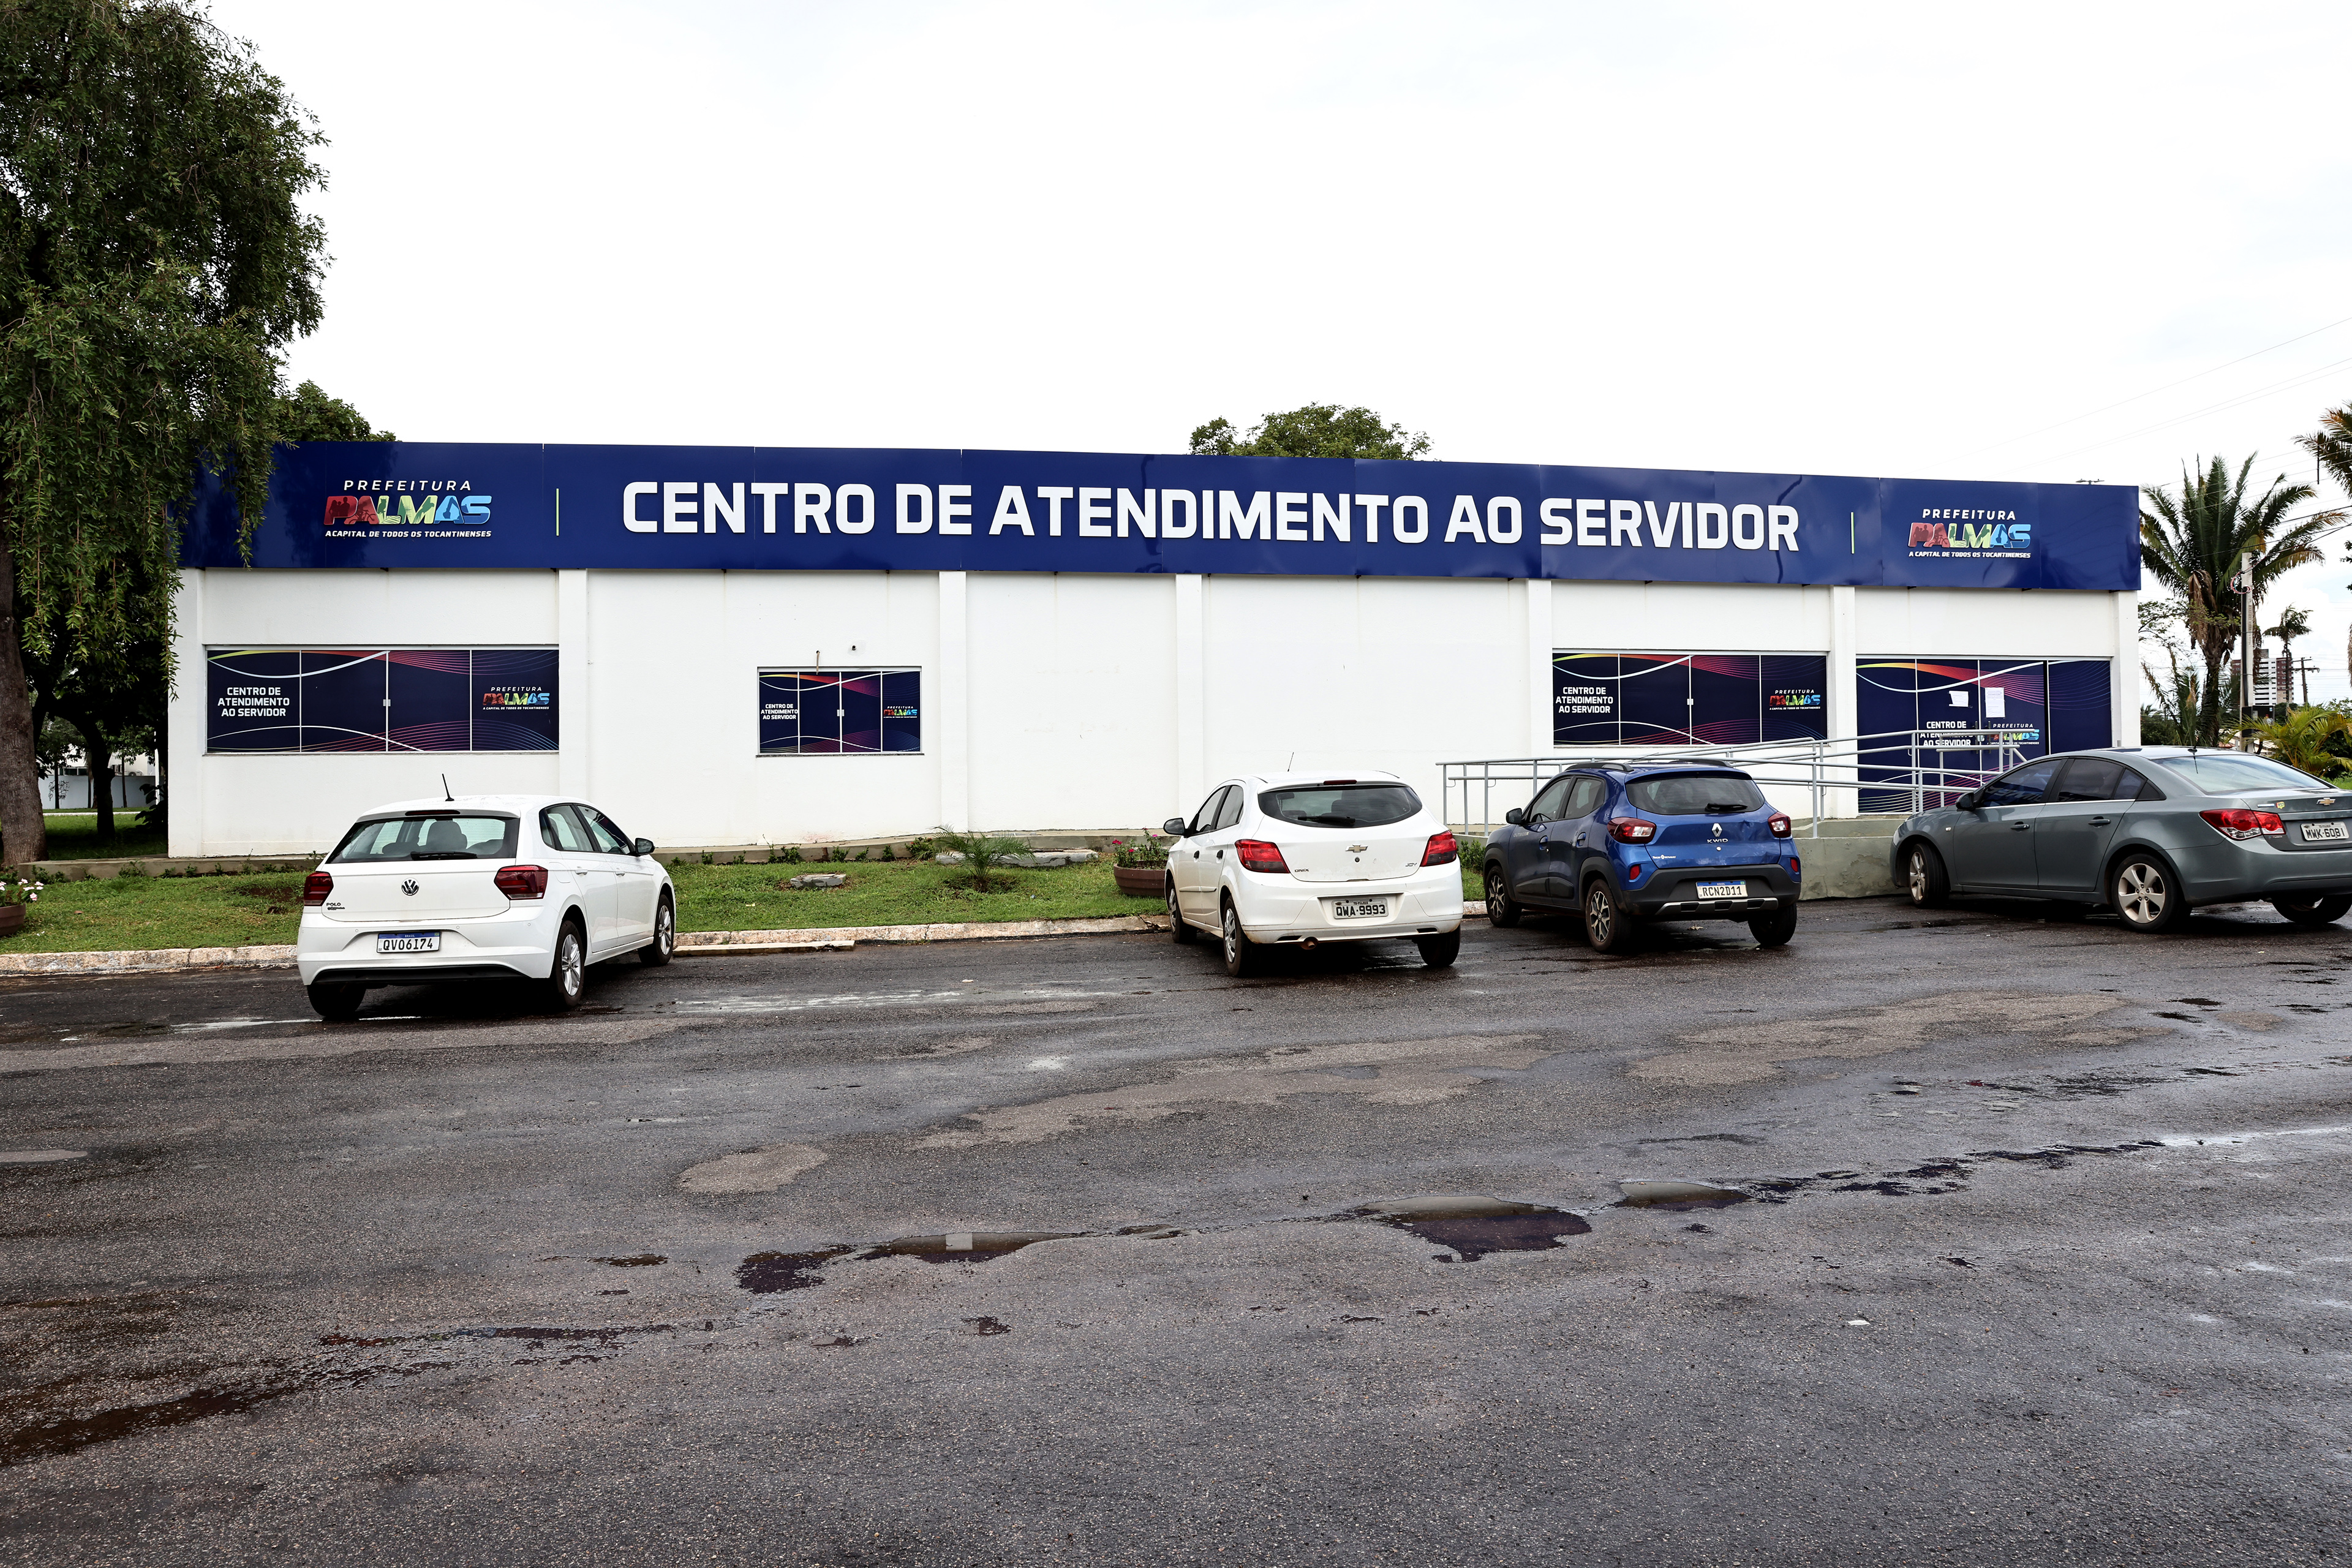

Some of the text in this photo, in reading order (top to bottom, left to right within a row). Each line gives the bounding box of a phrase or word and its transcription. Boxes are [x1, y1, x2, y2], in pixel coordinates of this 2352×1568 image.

[344, 480, 471, 491] PREFEITURA
[323, 495, 492, 525] PALMAS
[1922, 508, 2016, 521] PREFEITURA
[623, 481, 1801, 551] CENTRO DE ATENDIMENTO AO SERVIDOR
[1908, 522, 2032, 549] PALMAS
[227, 687, 281, 696] CENTRO DE
[217, 697, 290, 706] ATENDIMENTO
[483, 693, 550, 706] PALMAS
[1555, 696, 1613, 704] ATENDIMENTO
[1770, 695, 1821, 706] PALMAS
[221, 708, 286, 717] AO SERVIDOR
[1558, 705, 1611, 714] AO SERVIDOR
[1956, 720, 1967, 729] DE
[1703, 886, 1742, 897] RCN2D11
